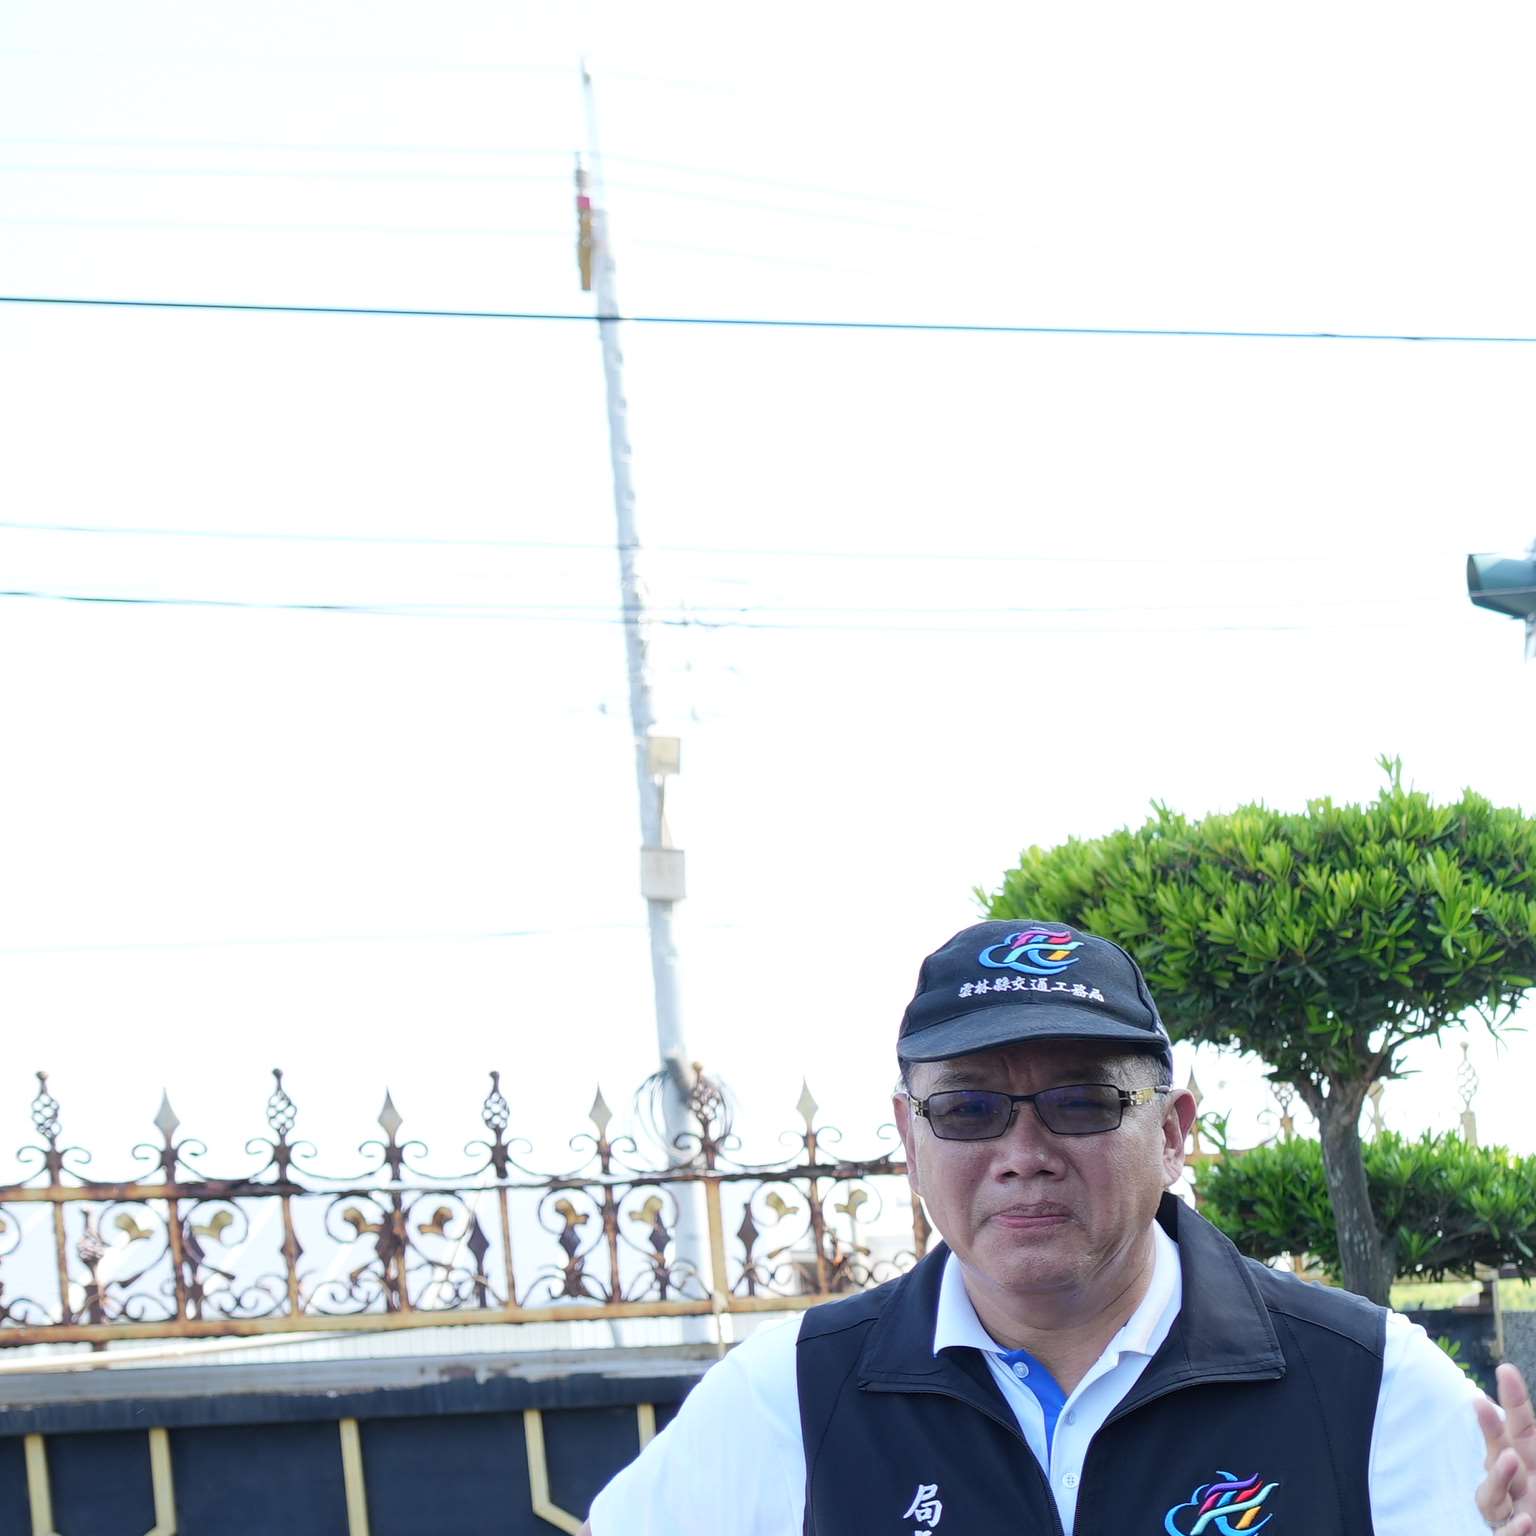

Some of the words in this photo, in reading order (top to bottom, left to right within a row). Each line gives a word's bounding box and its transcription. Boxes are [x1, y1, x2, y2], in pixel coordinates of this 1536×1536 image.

[958, 976, 1105, 1002] 雲林縣交通工務局
